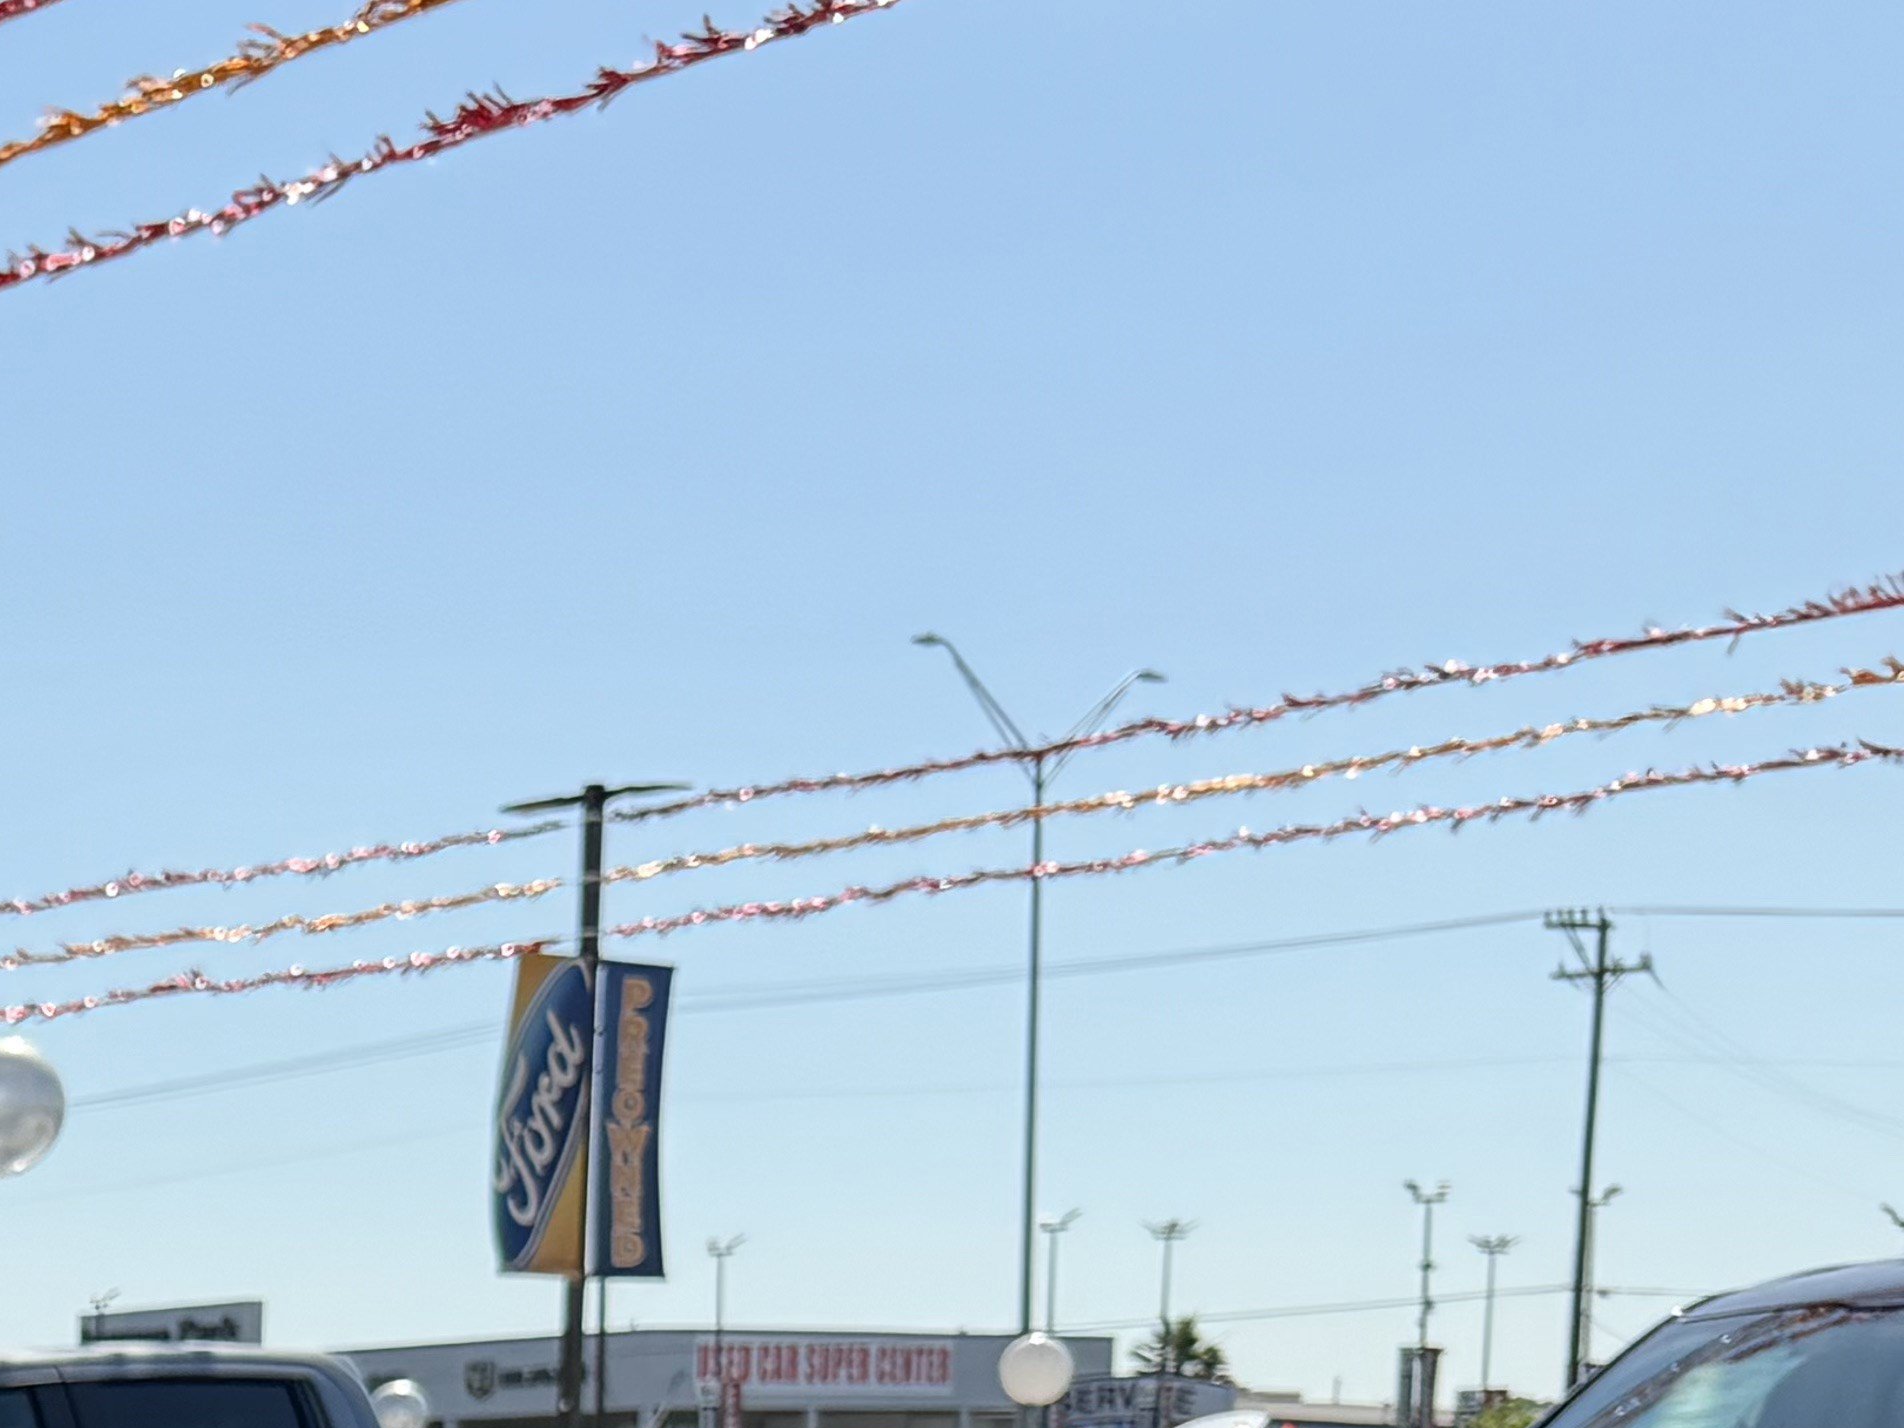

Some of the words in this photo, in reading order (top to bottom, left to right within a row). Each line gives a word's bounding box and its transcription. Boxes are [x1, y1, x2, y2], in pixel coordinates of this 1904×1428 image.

[493, 1008, 587, 1227] Ford
[757, 1344, 799, 1384] CAR
[804, 1344, 871, 1385] SUPER
[876, 1345, 952, 1386] CENTER
